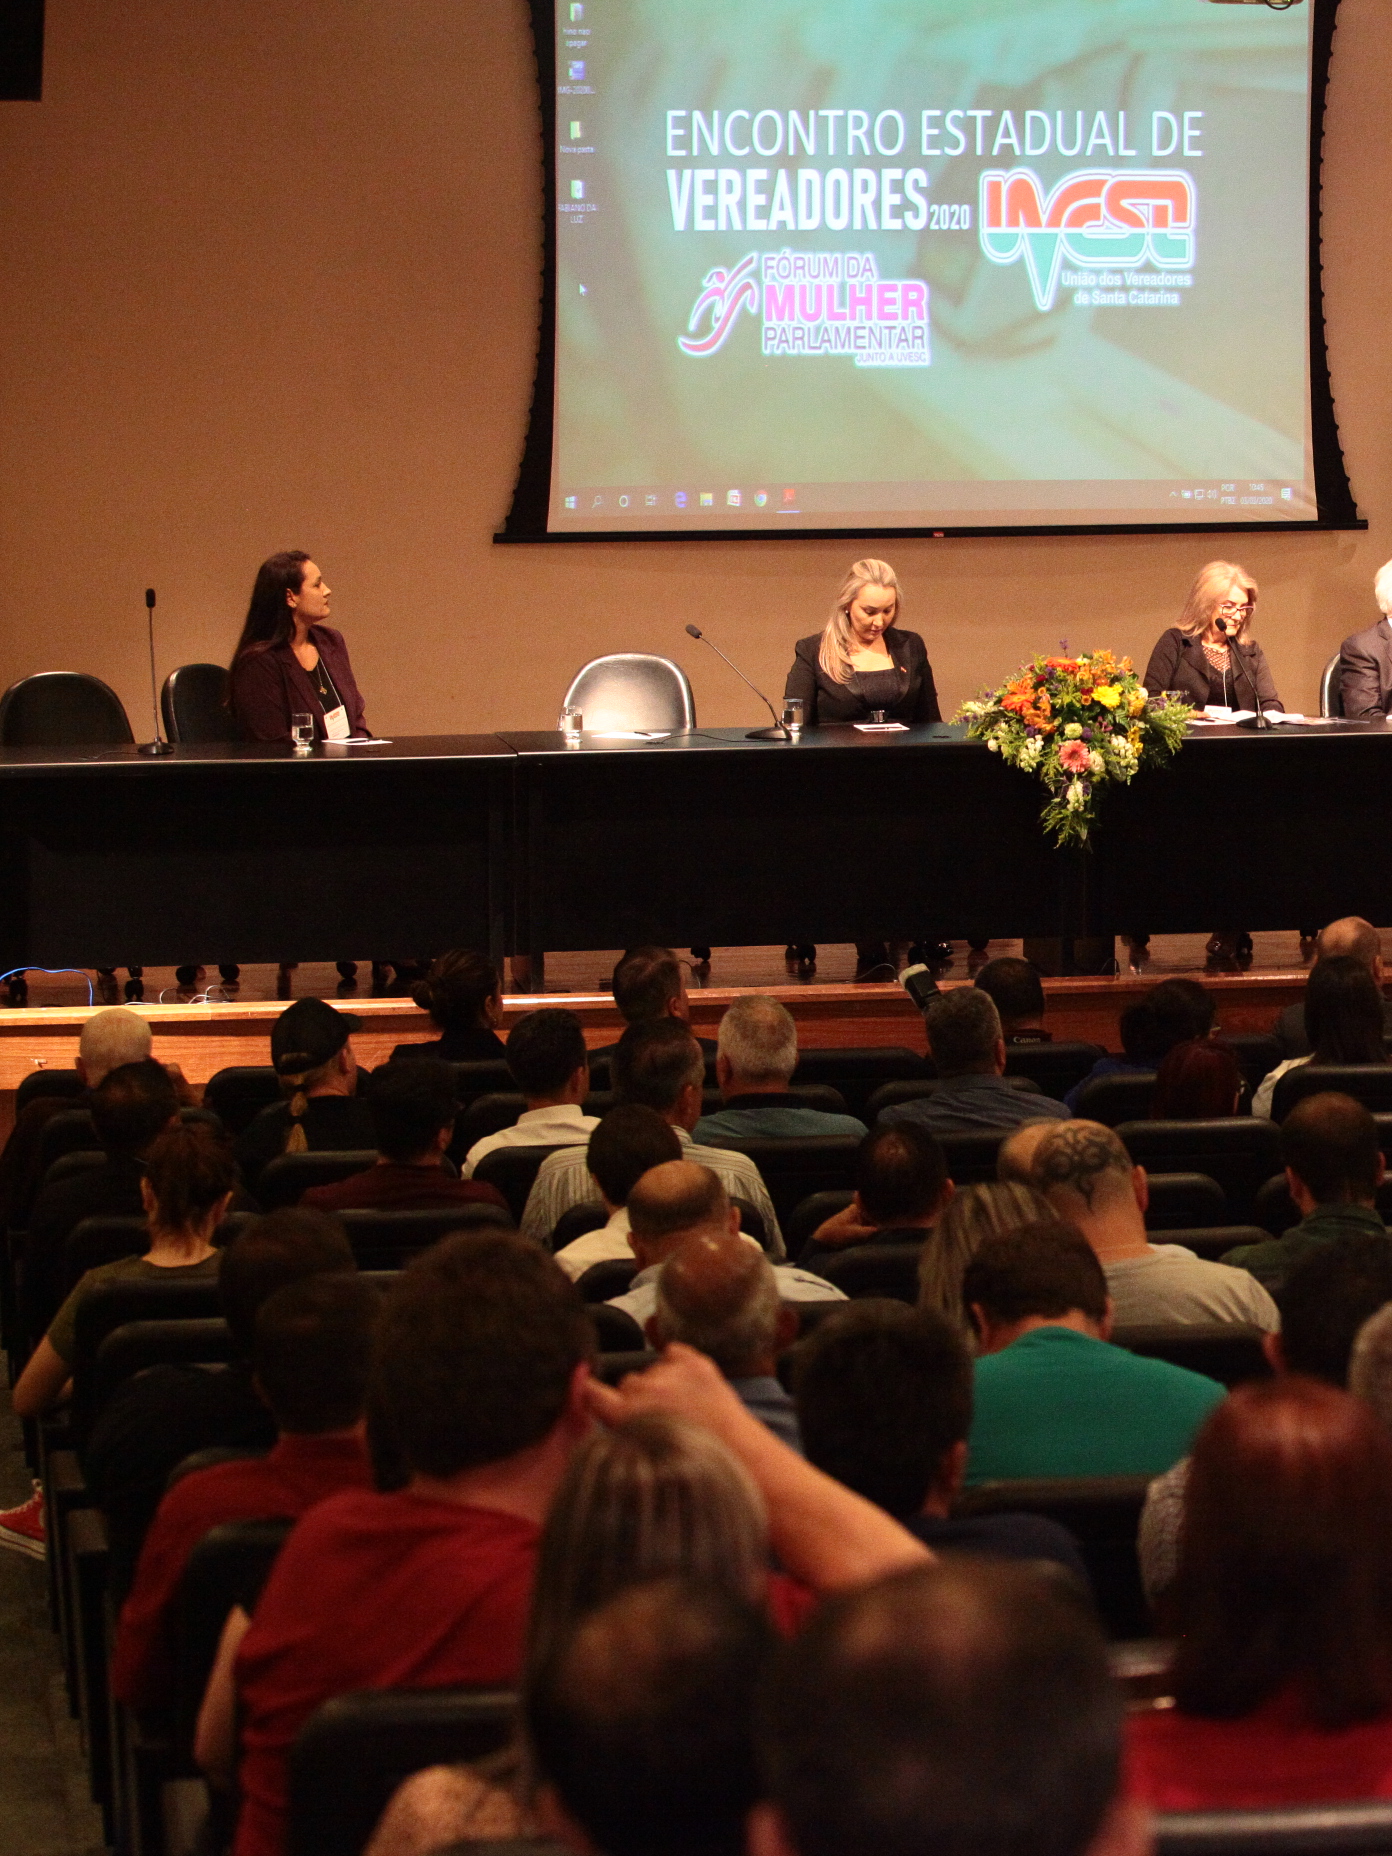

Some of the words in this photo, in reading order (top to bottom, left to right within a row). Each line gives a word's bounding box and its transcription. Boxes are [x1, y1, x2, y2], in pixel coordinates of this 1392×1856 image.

[666, 109, 904, 157] ENCONTRO
[921, 109, 1137, 157] ESTADUAL
[1150, 111, 1204, 157] DE
[666, 167, 929, 231] VEREADORES
[929, 204, 971, 231] 2020
[763, 249, 840, 280] FÓRUM
[846, 255, 875, 280] DA
[1061, 271, 1096, 286] União
[1099, 272, 1122, 286] dos
[1124, 272, 1191, 286] Vereadores
[764, 282, 927, 323] MULHER
[1073, 291, 1090, 305] de
[1092, 291, 1126, 305] Santa
[1128, 291, 1179, 305] Catarina
[763, 325, 926, 352] PARLAMENTAR
[856, 352, 886, 364] JUNTO
[888, 353, 895, 363] A
[896, 352, 927, 363] UVESC
[1013, 1036, 1041, 1044] Canon
